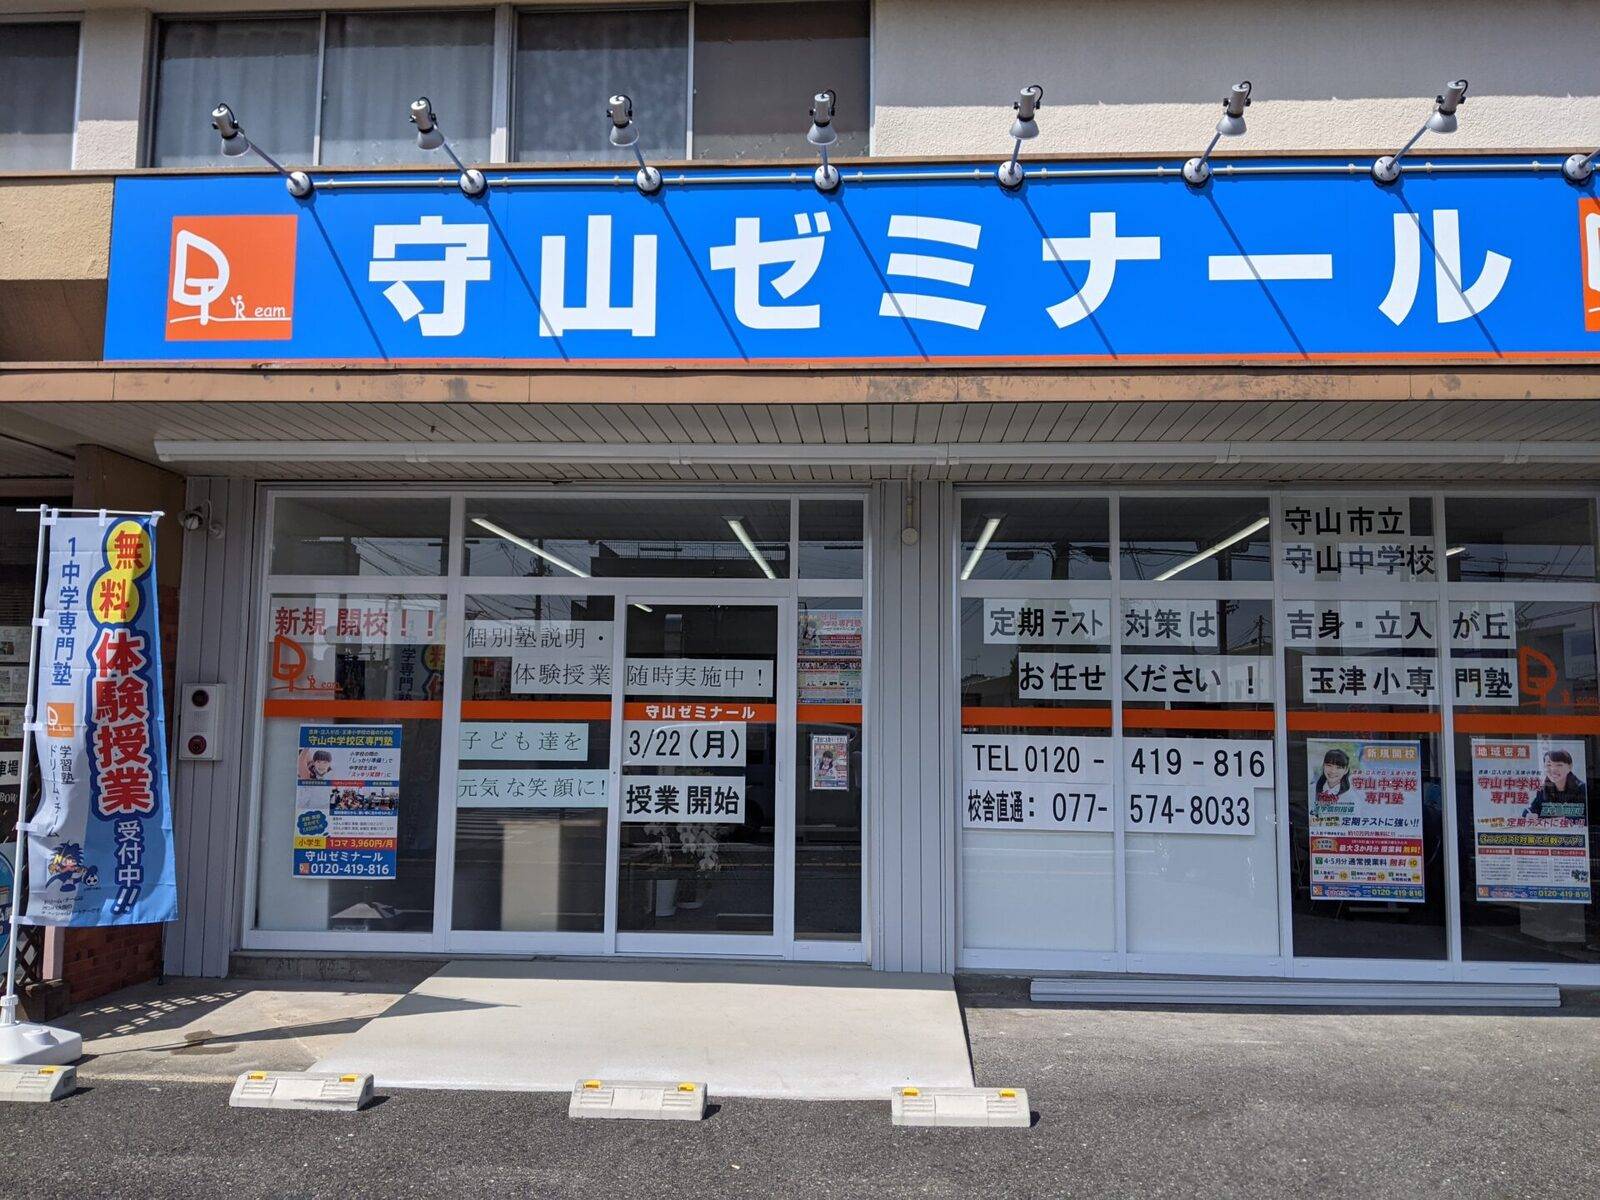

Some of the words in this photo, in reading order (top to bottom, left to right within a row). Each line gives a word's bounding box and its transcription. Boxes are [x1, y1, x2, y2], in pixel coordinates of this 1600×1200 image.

[369, 209, 1512, 337] 守山ゼミナール
[1285, 506, 1405, 536] 守山市立
[1285, 544, 1436, 575] 守山中学校
[98, 530, 145, 620] 無料
[95, 630, 153, 813] 体験授業
[645, 704, 756, 720] 守山ゼミナール
[309, 736, 393, 746] 守山中学校区専門塾
[460, 730, 583, 752] 子ども達を
[60, 745, 76, 785] 学習塾
[1352, 777, 1417, 791] 守山中学校
[1478, 777, 1543, 790] 守山中学校
[625, 783, 740, 816] 授業開始
[1364, 791, 1405, 804] 専門塾
[1490, 791, 1530, 805] 専門塾
[305, 851, 384, 862] 守山ゼミナール
[311, 863, 390, 875] 0120-419-816
